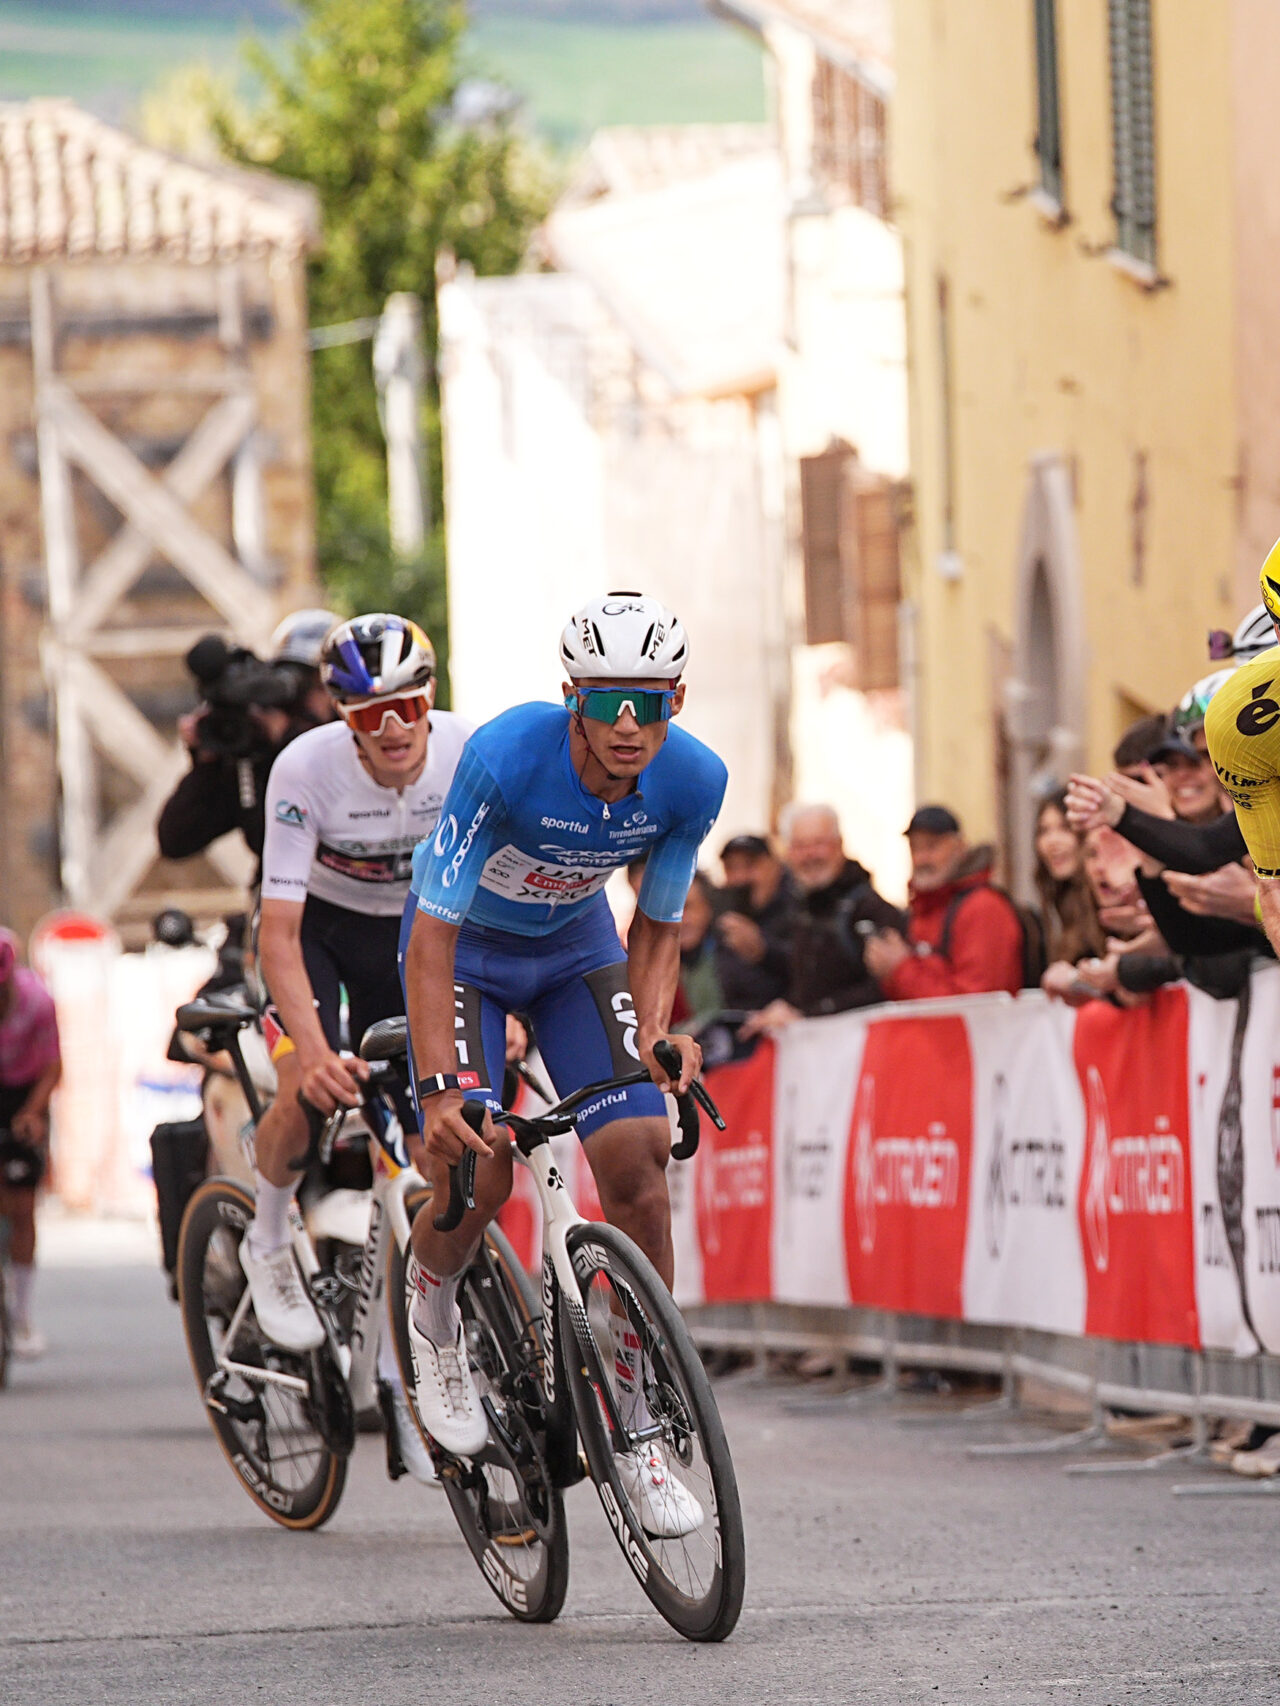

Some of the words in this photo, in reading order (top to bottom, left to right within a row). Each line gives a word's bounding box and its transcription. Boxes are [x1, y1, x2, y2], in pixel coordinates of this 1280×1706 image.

[582, 618, 597, 657] MET
[649, 620, 666, 661] MET
[540, 816, 589, 835] sportful
[577, 1090, 627, 1122] sportful
[543, 1262, 556, 1403] COLNAGO
